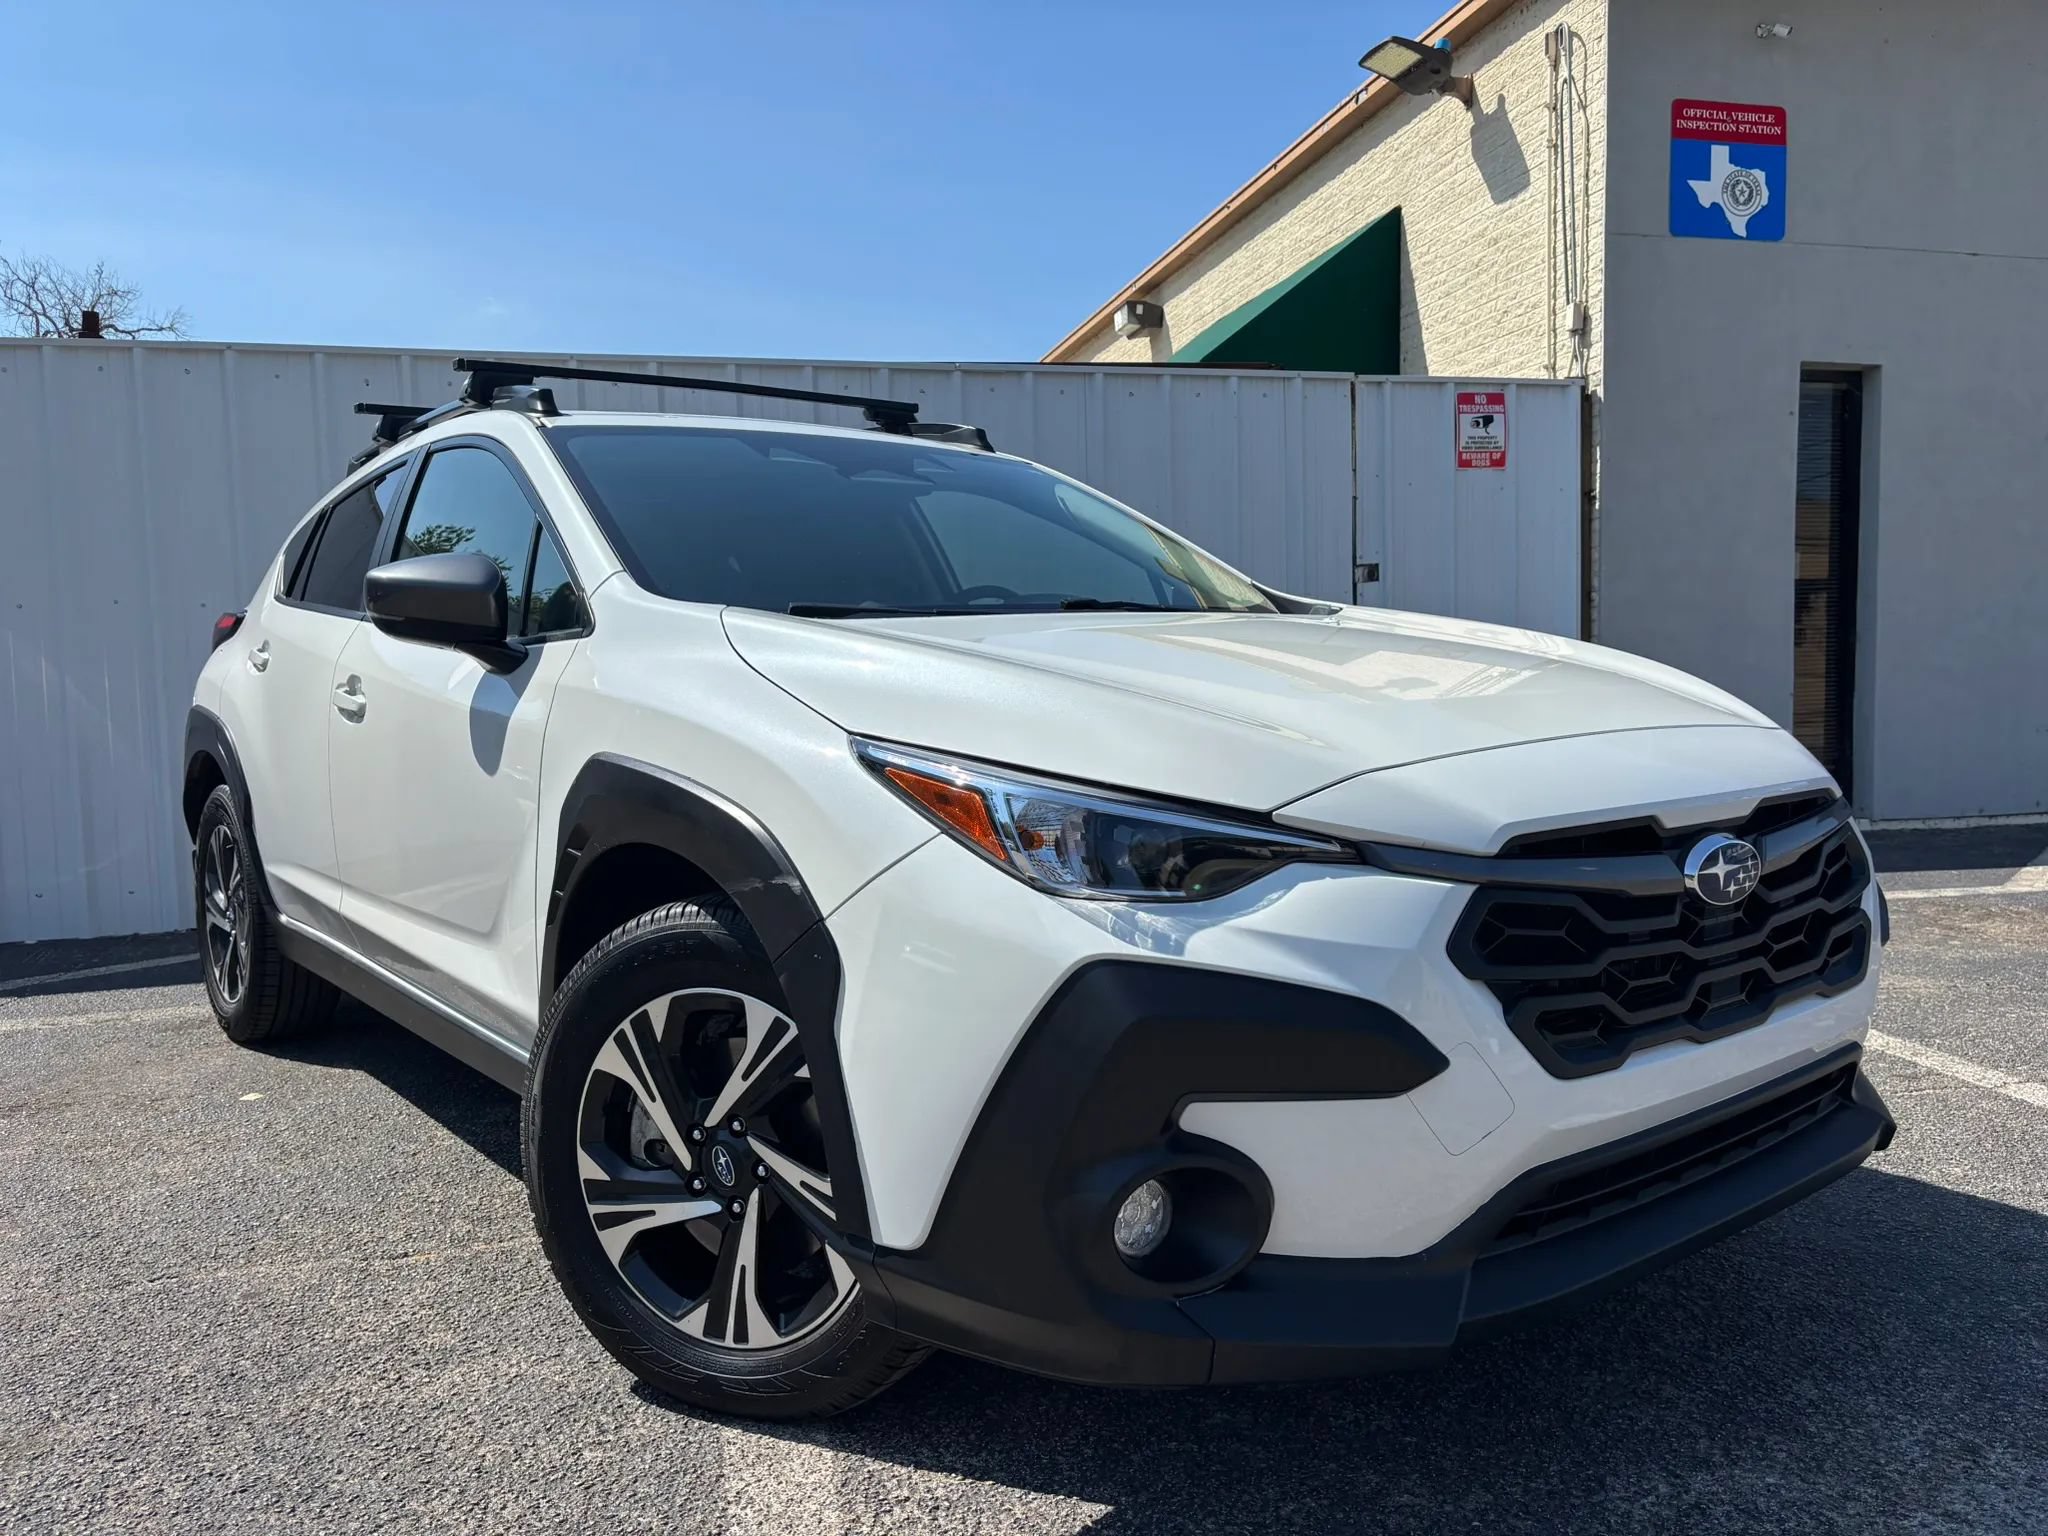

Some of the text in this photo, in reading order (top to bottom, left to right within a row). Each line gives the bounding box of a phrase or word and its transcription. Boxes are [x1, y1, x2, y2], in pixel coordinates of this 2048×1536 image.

[1683, 108, 1775, 123] OFFICIAL VEHICLE
[1676, 119, 1782, 135] INSPECTION STATION
[1474, 394, 1486, 404] NO
[1459, 404, 1504, 413] TRESPASSING
[1462, 452, 1501, 460] BEWARE OF
